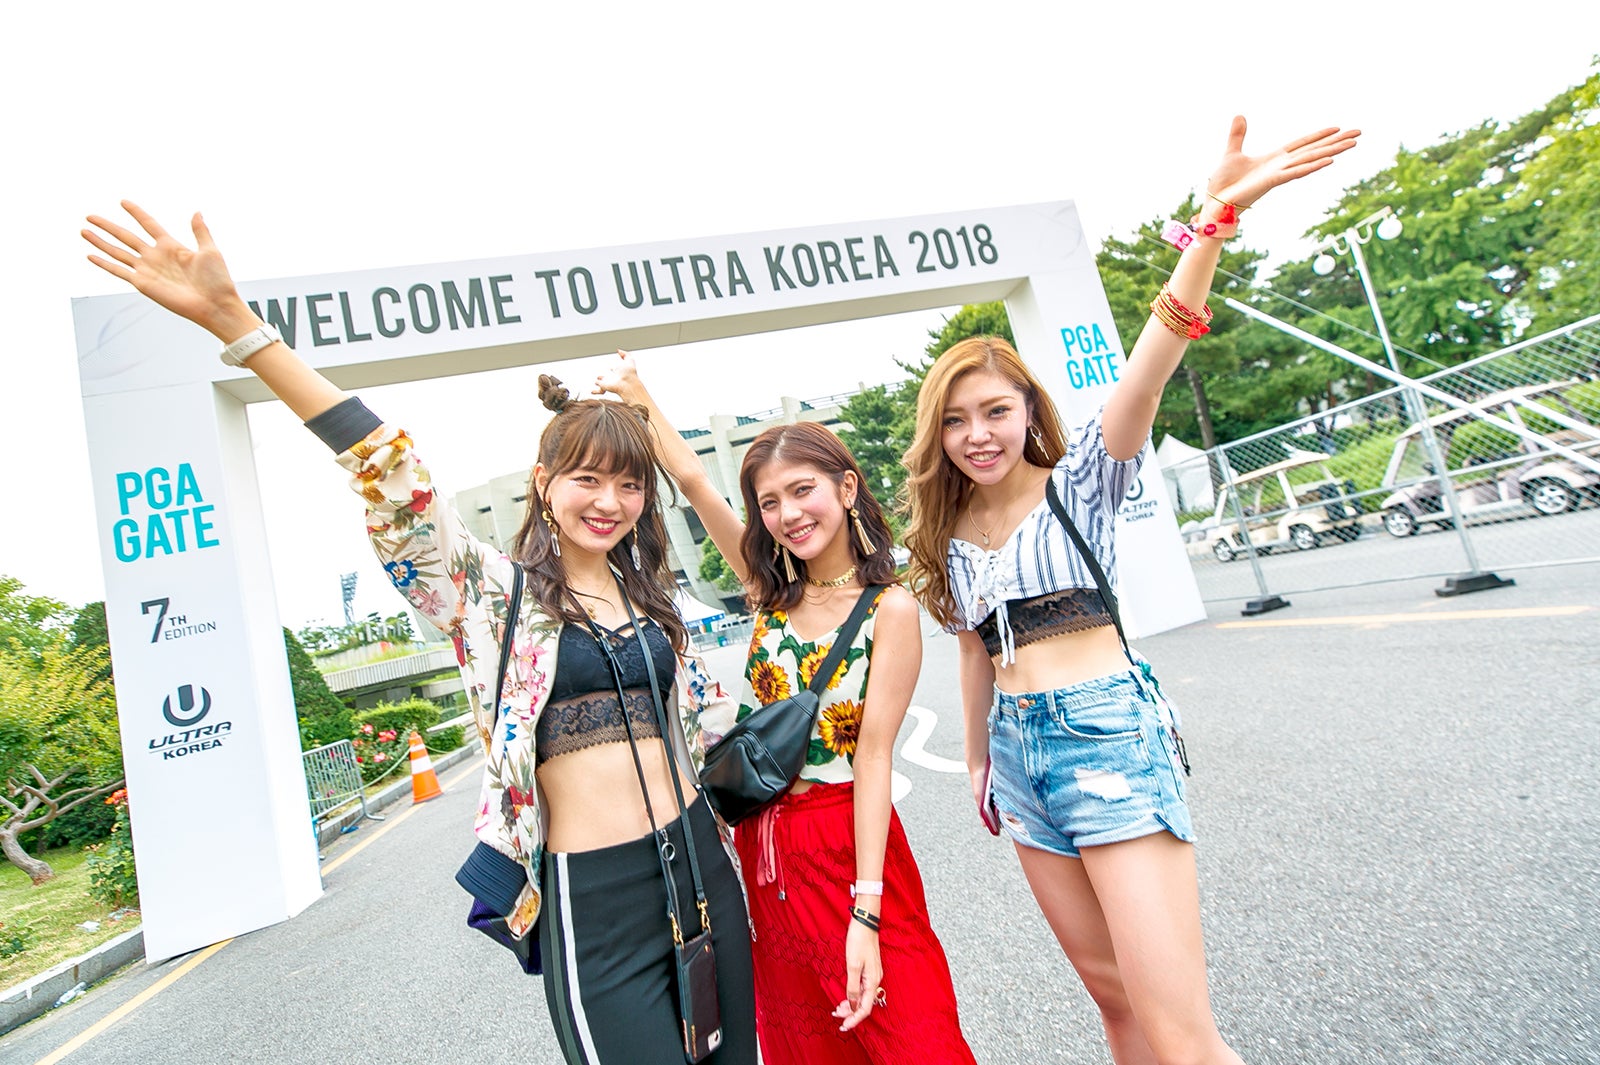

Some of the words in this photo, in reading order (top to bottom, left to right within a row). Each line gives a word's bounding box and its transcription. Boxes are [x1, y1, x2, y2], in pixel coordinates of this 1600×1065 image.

[248, 274, 521, 350] WELCOME
[534, 266, 599, 318] TO
[611, 250, 755, 310] ULTRA
[762, 235, 900, 292] KOREA
[908, 223, 999, 273] 2018
[1060, 323, 1109, 357] PGA
[1066, 353, 1119, 389] GATE
[116, 462, 203, 516] PGA
[113, 504, 220, 563] GATE
[1125, 511, 1155, 523] KOREA
[164, 621, 216, 641] EDITION
[148, 721, 232, 750] ULTRA
[163, 739, 223, 760] KOREA
